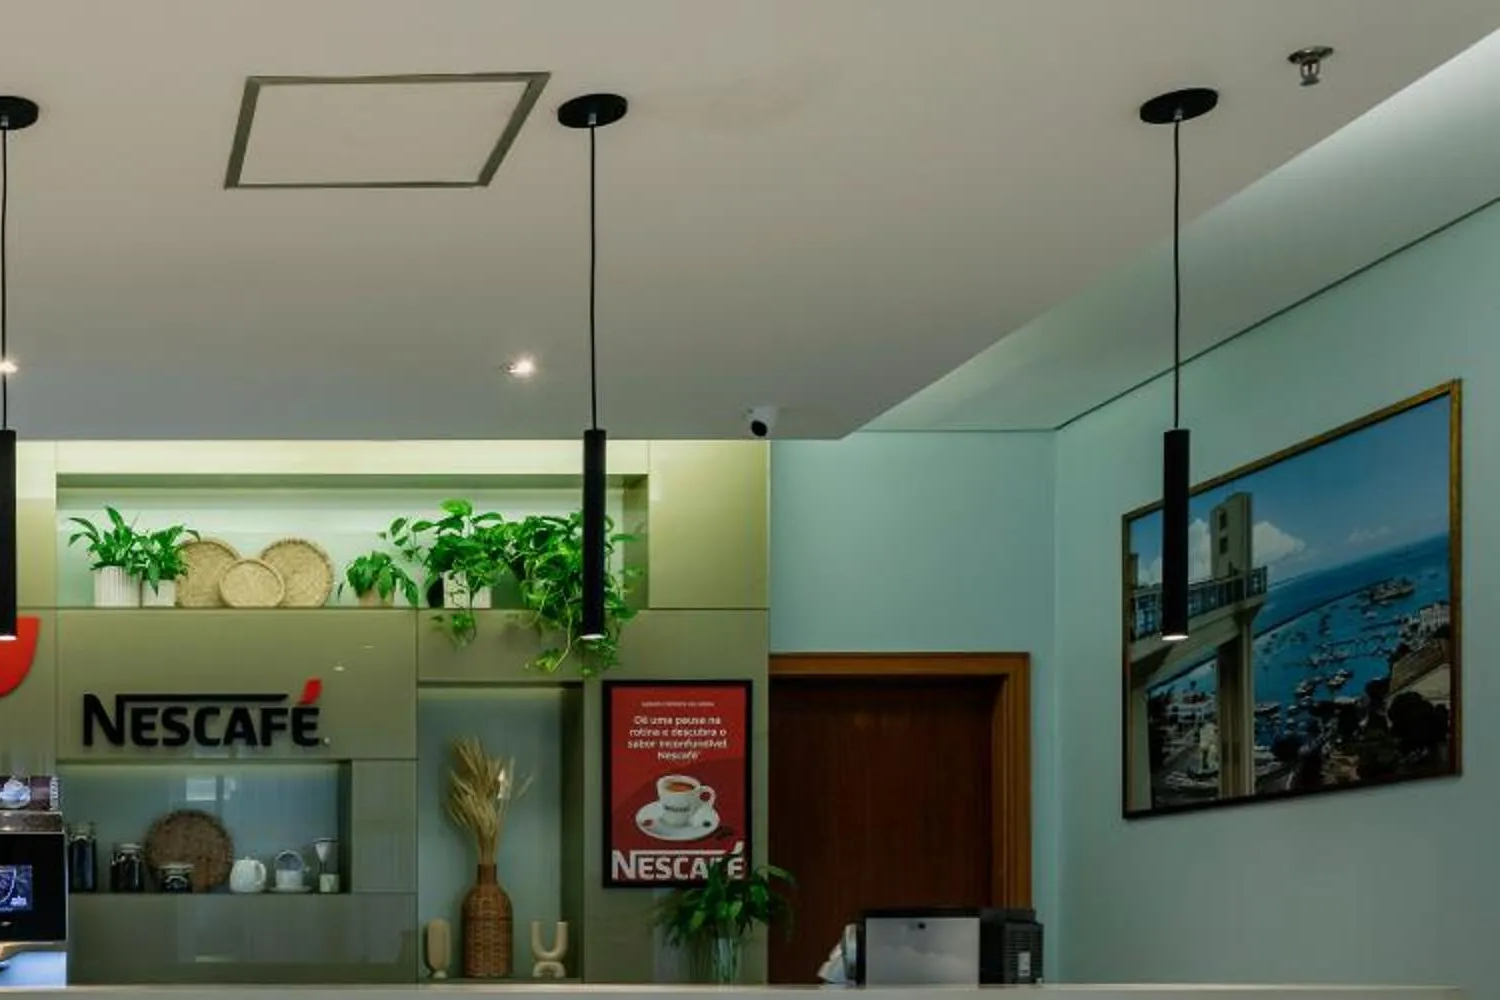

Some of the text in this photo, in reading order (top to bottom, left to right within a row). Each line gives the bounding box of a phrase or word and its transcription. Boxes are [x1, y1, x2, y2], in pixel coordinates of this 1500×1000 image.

[83, 677, 322, 747] NESCAFÉ
[650, 717, 673, 725] uma
[675, 717, 705, 727] pausa
[707, 717, 721, 725] na
[629, 728, 660, 737] rotina
[671, 727, 717, 737] descubra
[719, 729, 727, 737] o
[627, 738, 727, 749] sabor inconfundível
[611, 840, 745, 880] NESCAÉ
